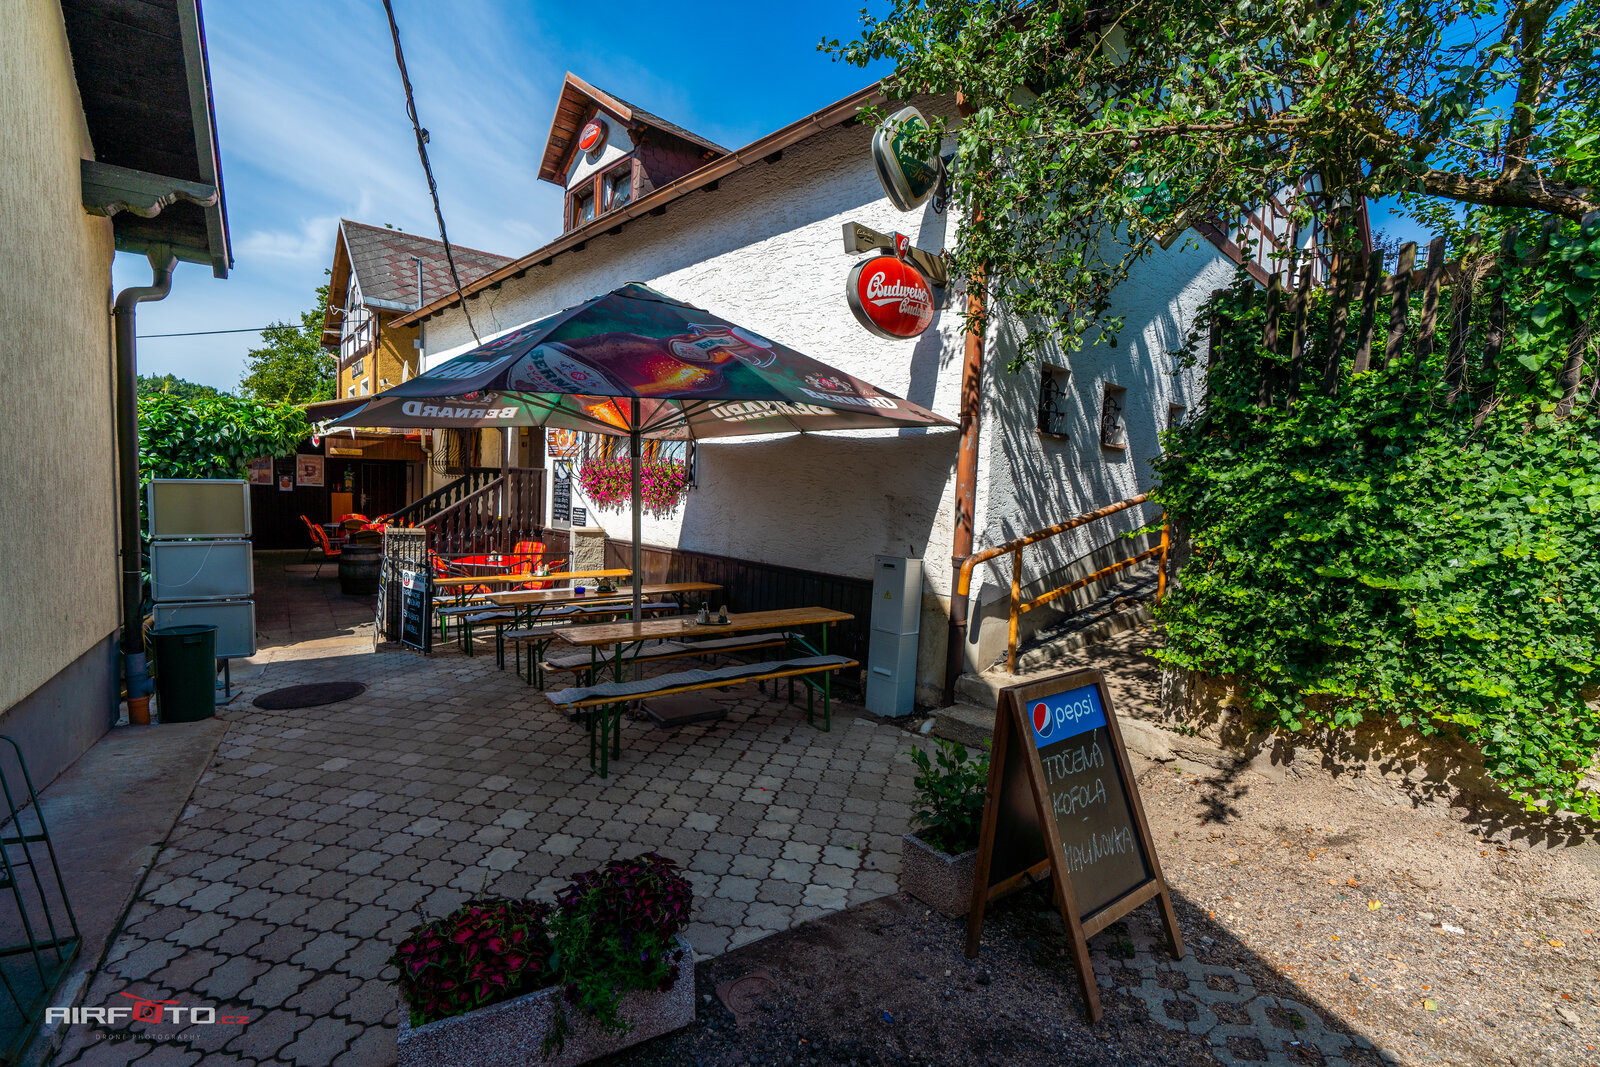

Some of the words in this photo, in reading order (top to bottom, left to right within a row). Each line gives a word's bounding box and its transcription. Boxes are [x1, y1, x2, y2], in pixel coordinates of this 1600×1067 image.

[866, 271, 931, 306] Budweiser
[1055, 693, 1095, 729] pepsi
[1042, 728, 1105, 785] TOČENÁ
[1053, 778, 1107, 822] KOFOLA
